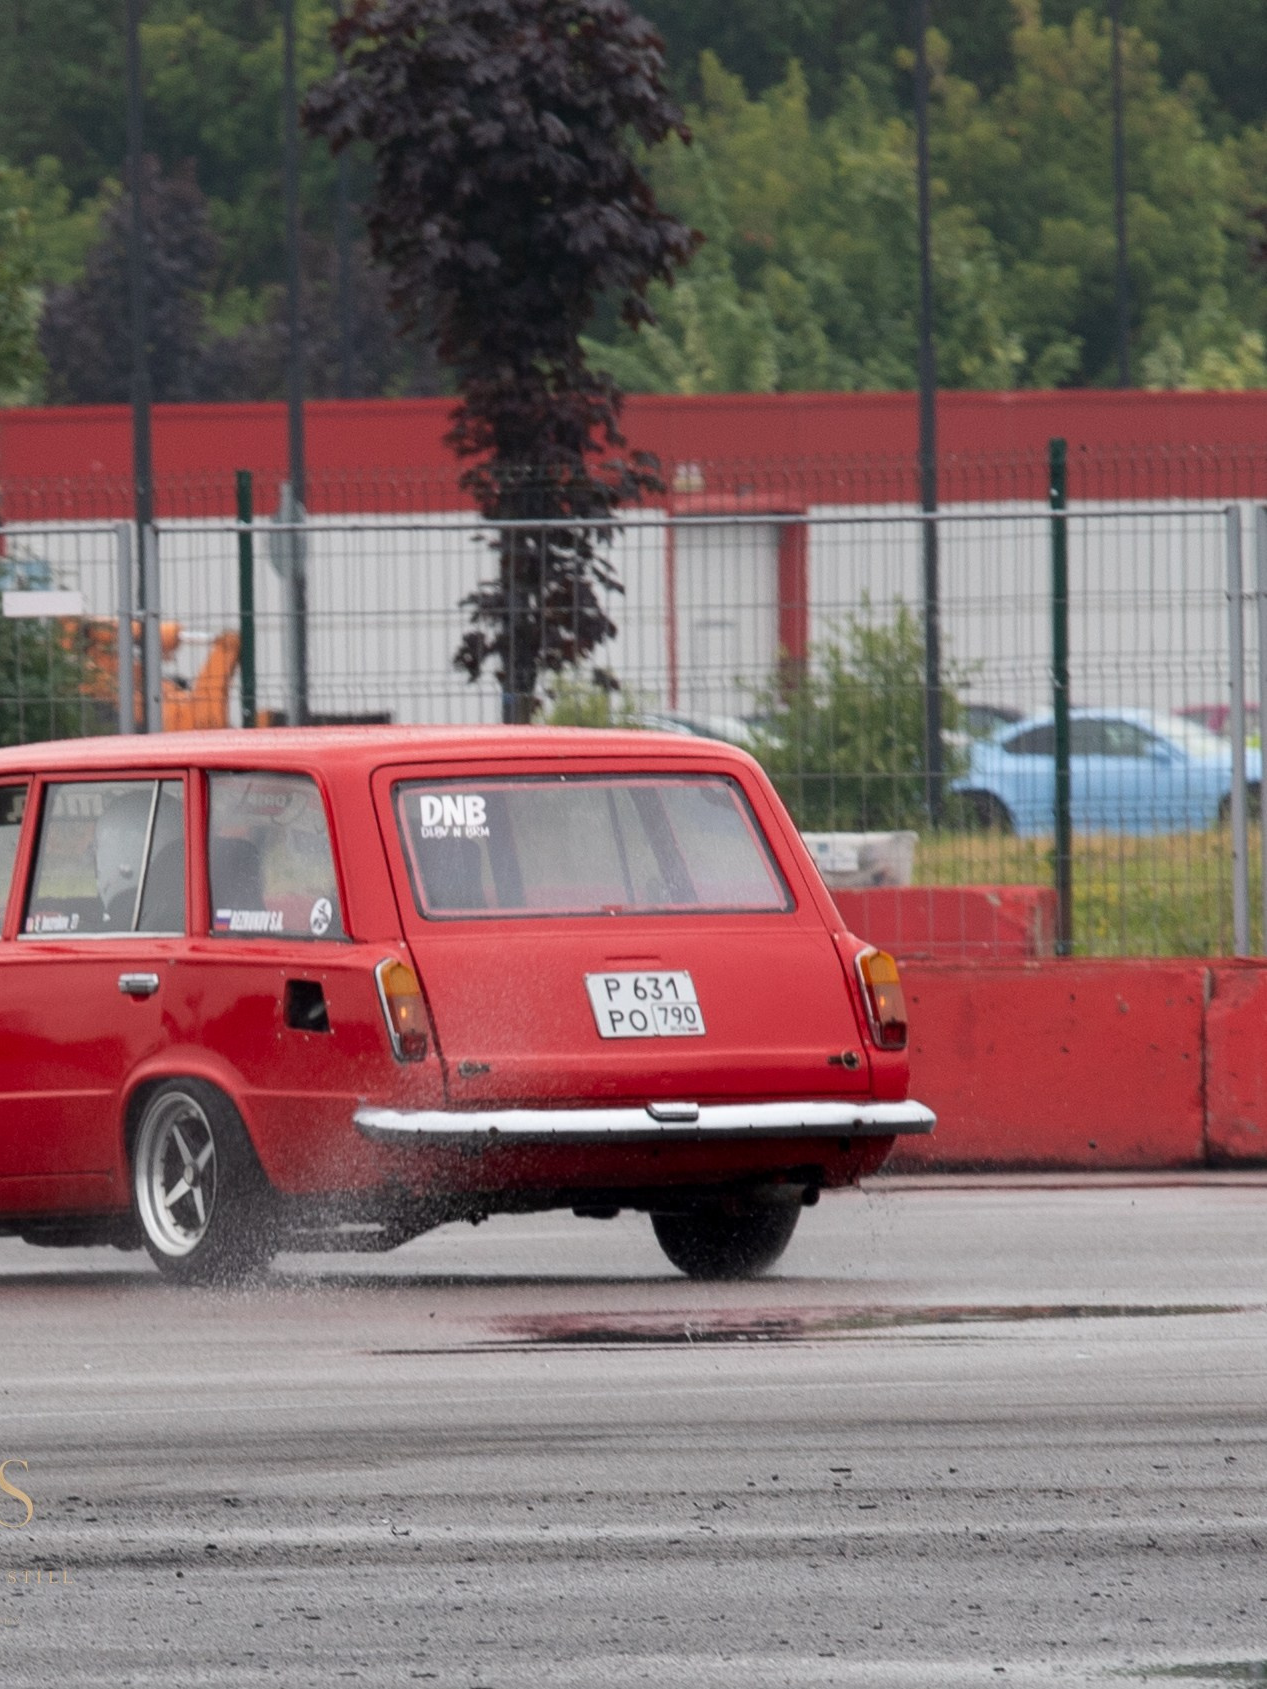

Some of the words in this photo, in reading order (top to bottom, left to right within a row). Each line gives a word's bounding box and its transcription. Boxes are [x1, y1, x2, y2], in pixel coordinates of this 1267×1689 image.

[420, 794, 487, 828] DNB
[633, 976, 680, 1001] 631
[657, 1005, 697, 1026] 790
